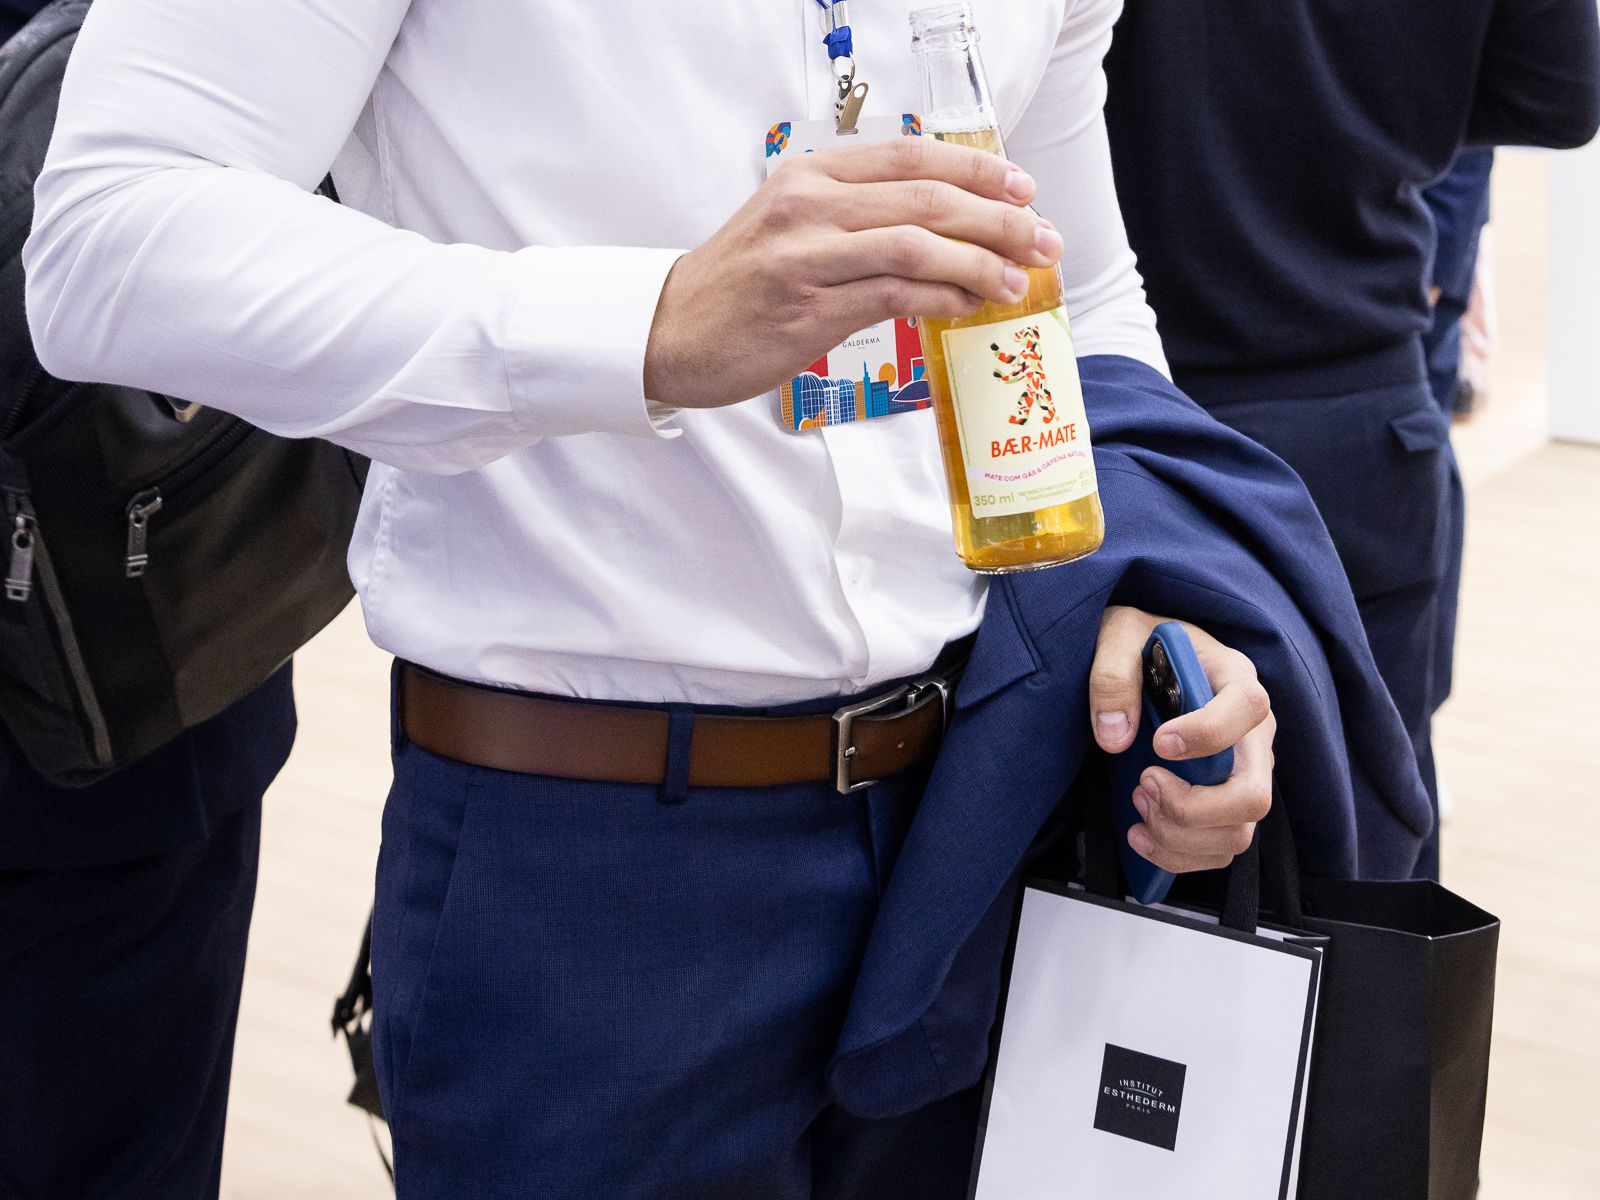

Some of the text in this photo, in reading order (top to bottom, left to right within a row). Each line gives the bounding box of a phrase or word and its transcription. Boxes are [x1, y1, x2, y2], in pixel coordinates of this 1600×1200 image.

[842, 337, 881, 348] GALDERMA
[984, 472, 1002, 481] MATE
[974, 494, 996, 506] 350
[1000, 492, 1015, 504] ml
[1119, 1079, 1163, 1097] INSTITUT
[1104, 1086, 1176, 1113] ESTHEDERM
[1126, 1103, 1151, 1114] PARIS
